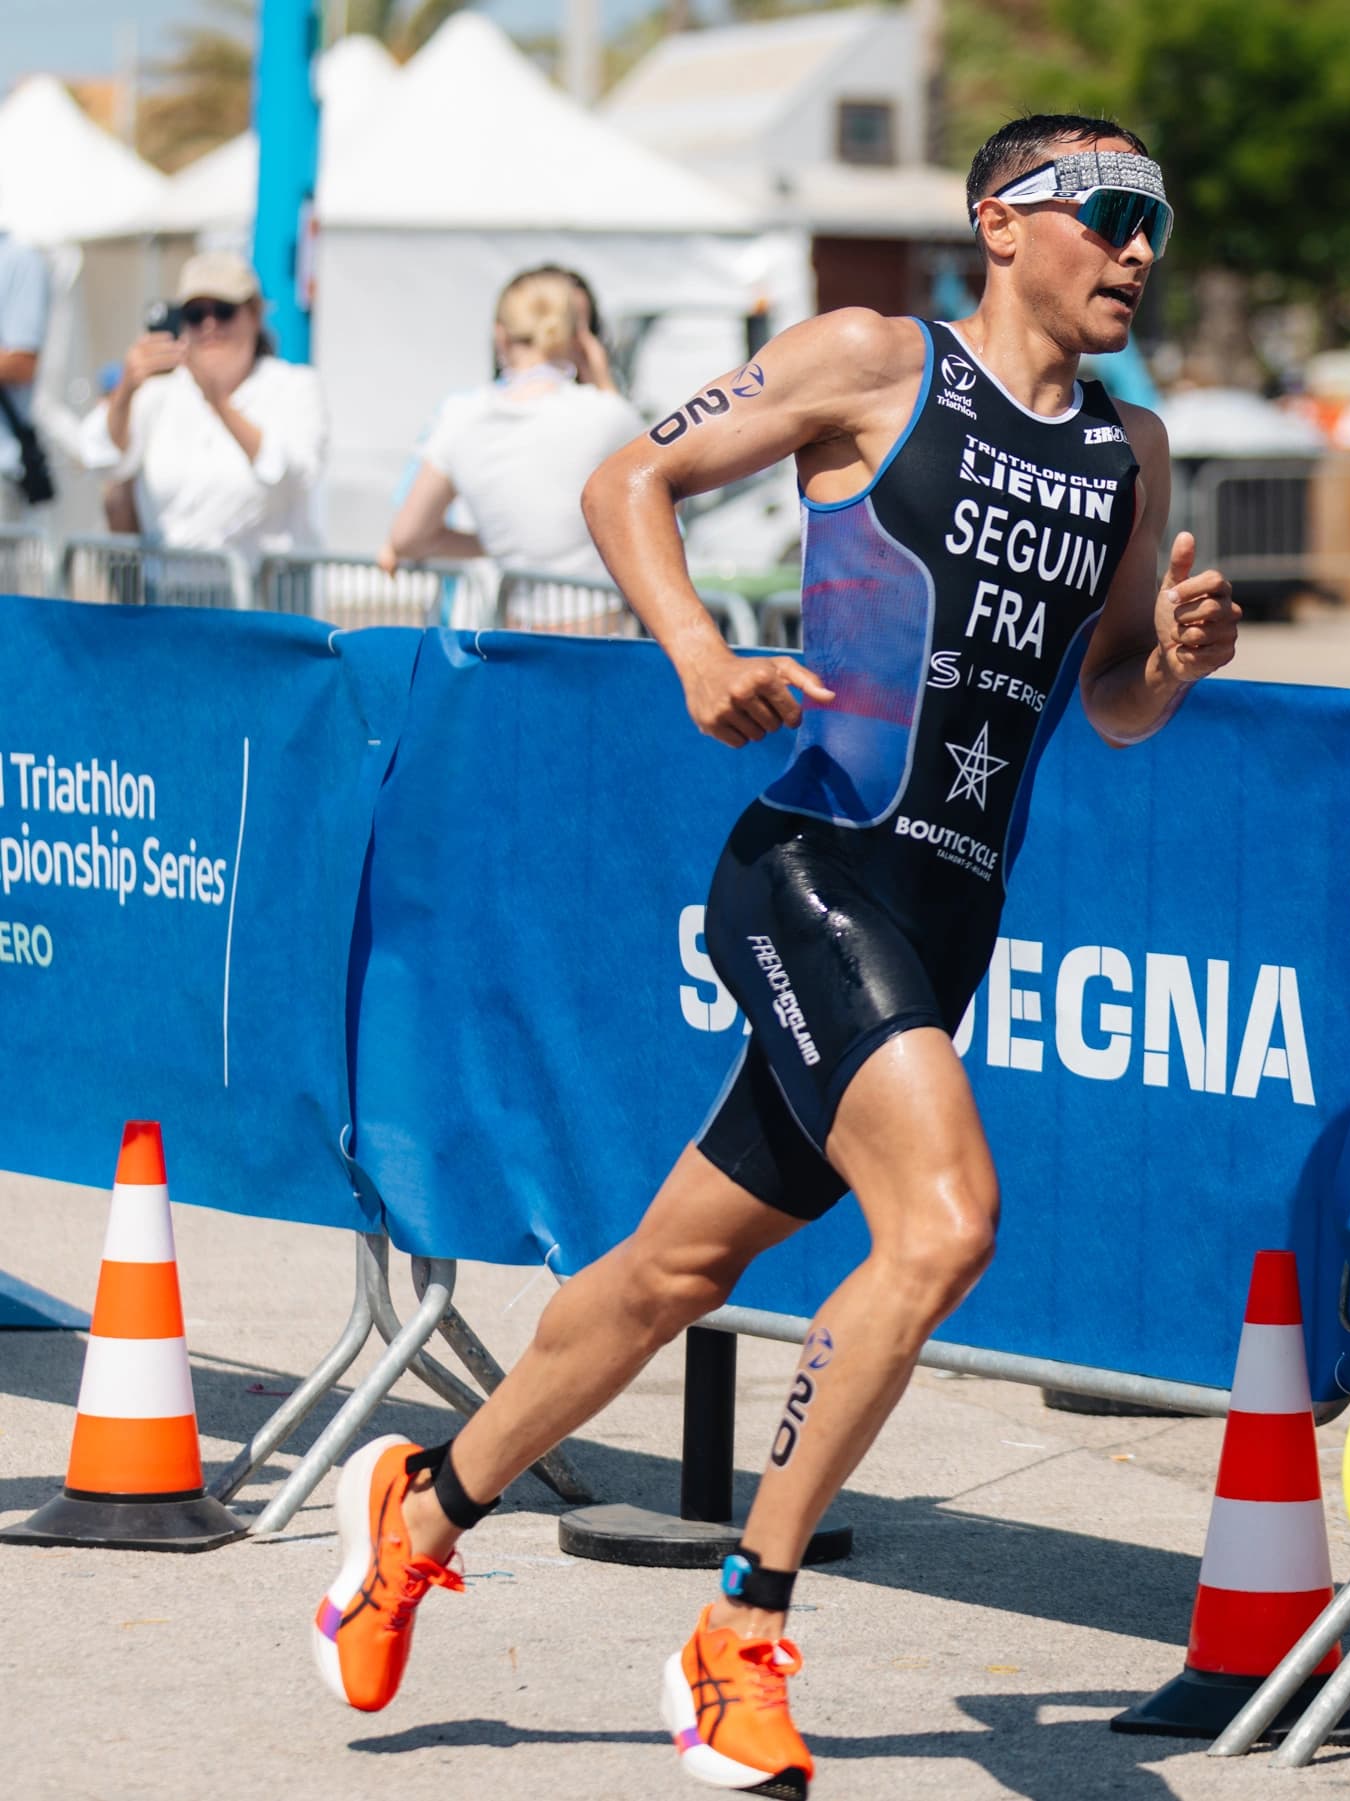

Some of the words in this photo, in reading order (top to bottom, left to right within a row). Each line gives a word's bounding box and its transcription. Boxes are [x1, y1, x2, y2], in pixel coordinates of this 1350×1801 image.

[649, 388, 731, 446] 20
[936, 395, 977, 421] Triathlon
[943, 388, 972, 408] World
[959, 448, 1114, 524] LIEVIN
[966, 434, 1066, 482] TRIATHLON
[1070, 475, 1118, 491] CLUB
[945, 499, 1107, 597] SEGUIN
[965, 580, 1046, 659] FRA
[10, 751, 156, 821] Triathlon
[143, 837, 227, 906] Series
[895, 815, 999, 870] BOUTICYCLE
[678, 904, 1317, 1106] SEGNA
[771, 1373, 813, 1467] 20
